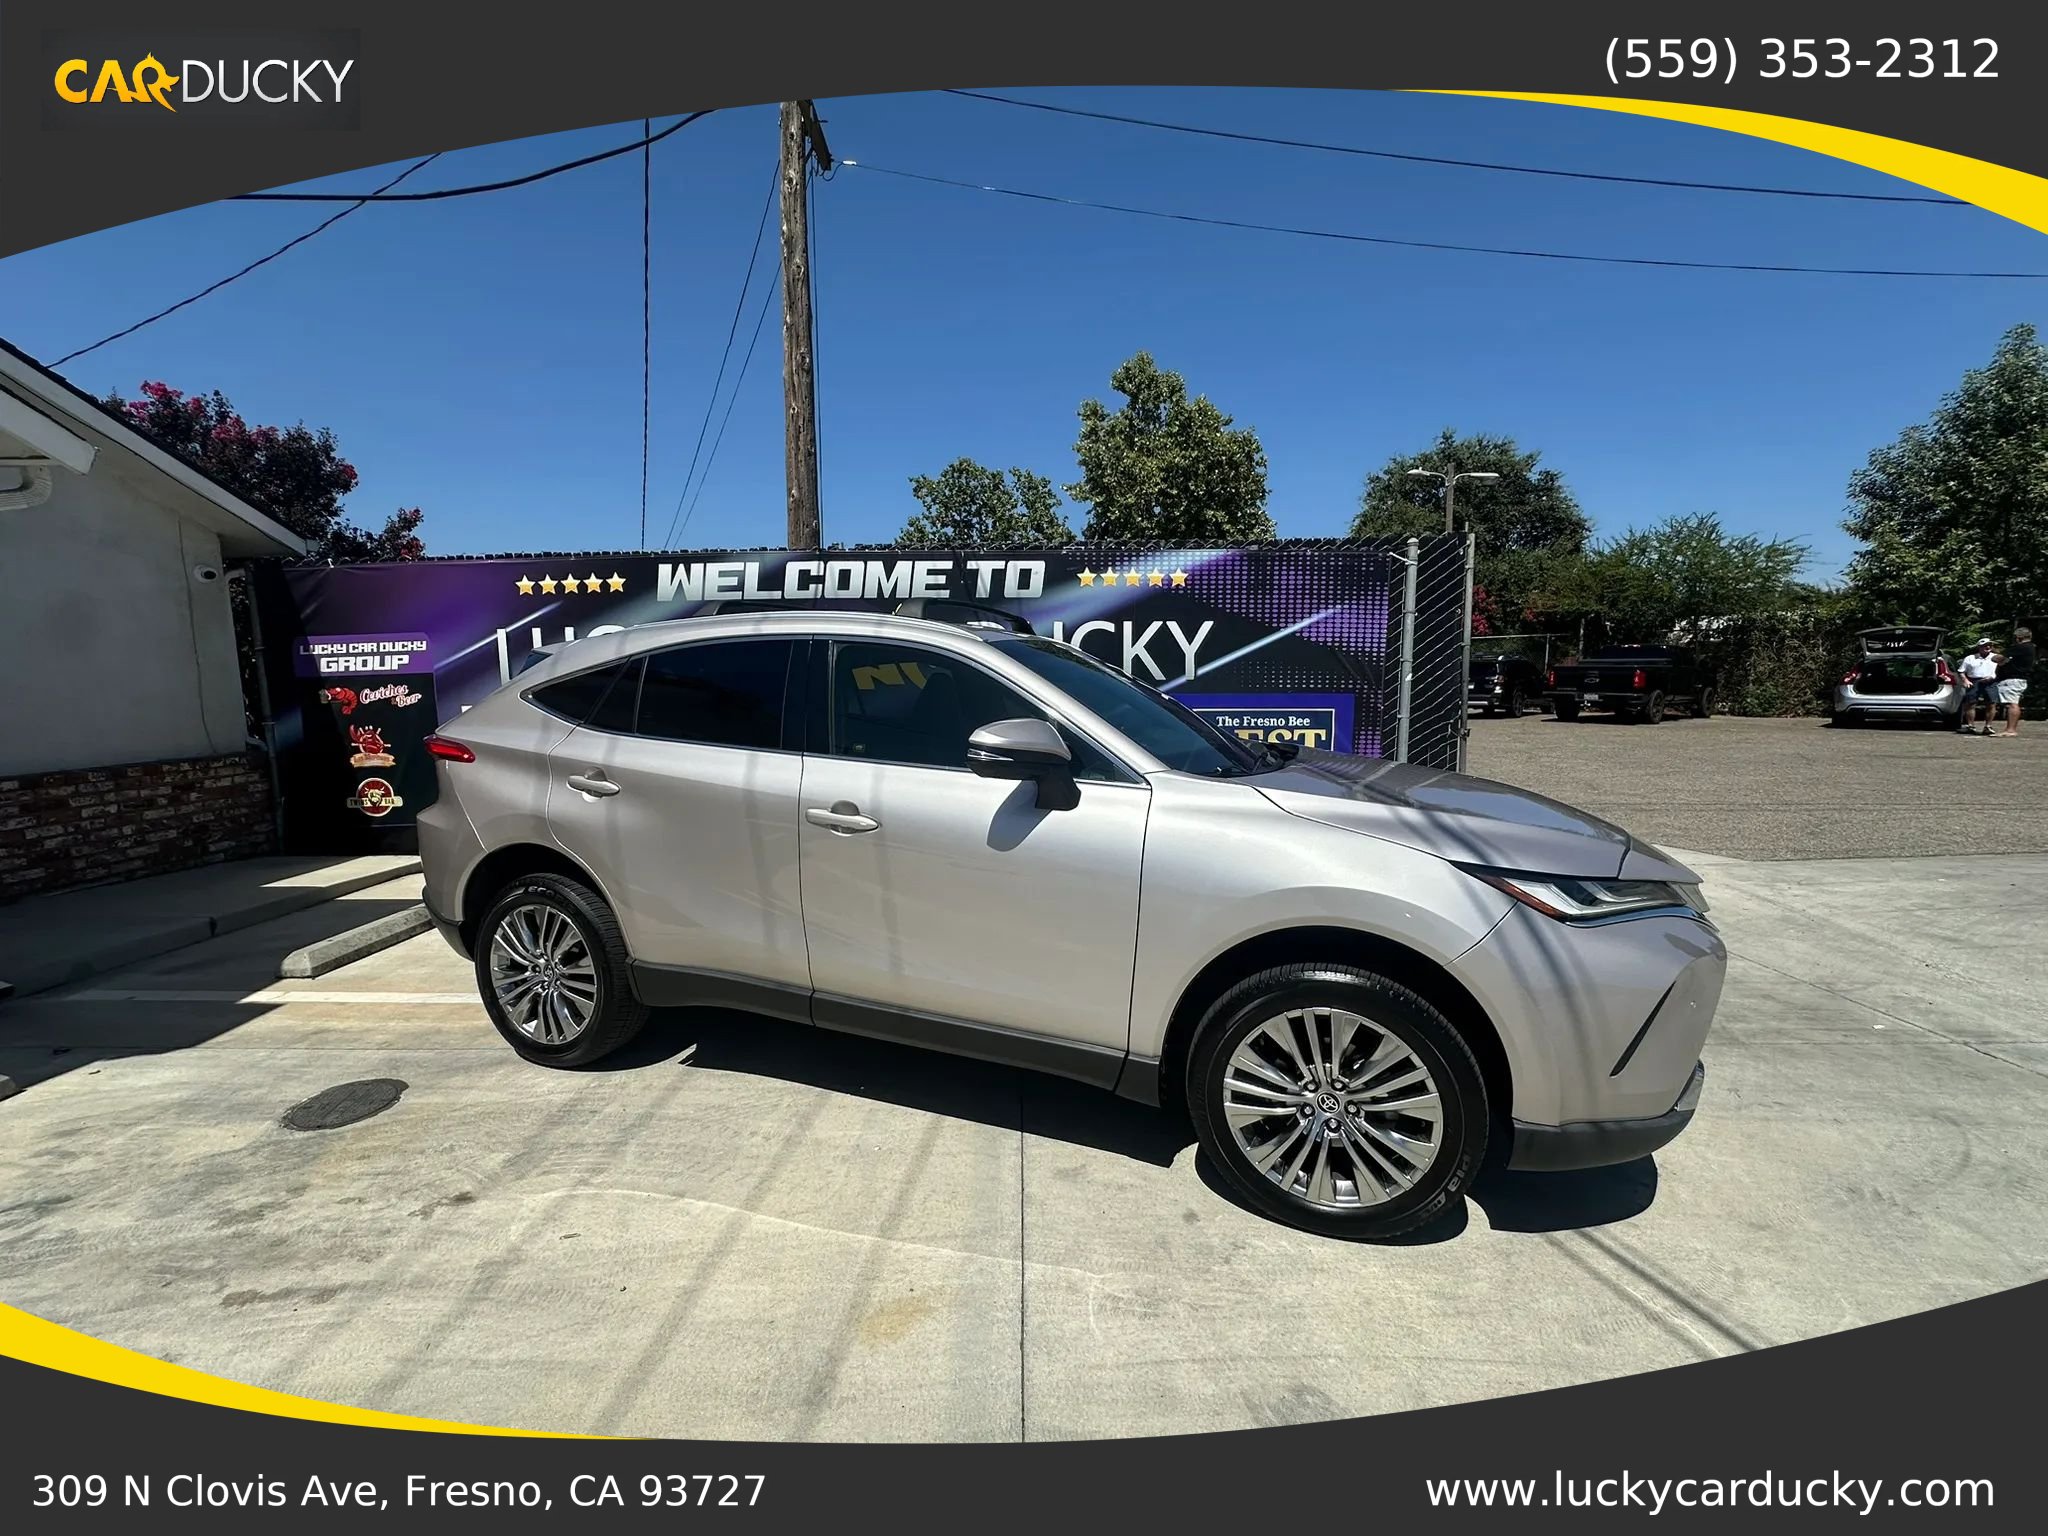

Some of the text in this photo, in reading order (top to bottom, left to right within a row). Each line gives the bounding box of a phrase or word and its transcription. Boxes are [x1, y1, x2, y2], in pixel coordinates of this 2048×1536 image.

[657, 560, 1045, 601] WELCOME TO
[348, 642, 377, 653] CAR
[320, 654, 409, 672] GROUP
[359, 684, 409, 704] Ceviches
[396, 692, 422, 707] Beer
[1216, 716, 1311, 727] The Fresno Bee
